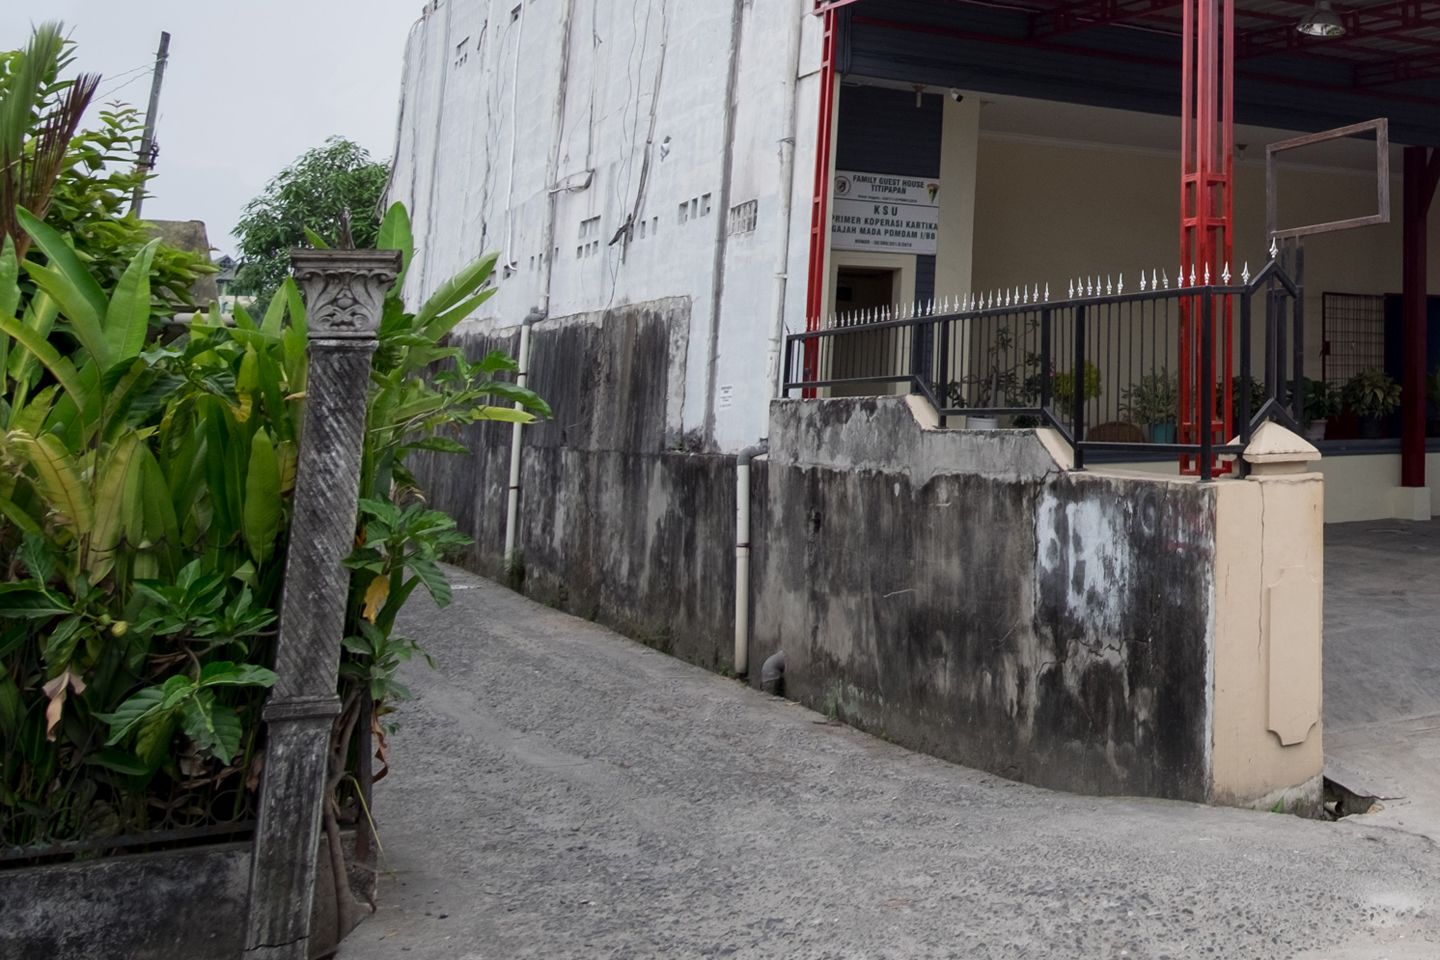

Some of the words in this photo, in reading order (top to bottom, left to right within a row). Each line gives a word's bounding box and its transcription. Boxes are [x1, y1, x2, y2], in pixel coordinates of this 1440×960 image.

[852, 174, 877, 184] FAMILY
[879, 177, 900, 186] GUEST
[902, 179, 924, 189] HOUSE
[871, 185, 907, 194] TITIPAPAN
[864, 217, 903, 228] KOPERASI
[906, 221, 938, 230] KARTIKA
[831, 225, 857, 234] GAJAH
[859, 227, 881, 236] MADA
[884, 228, 918, 239] POMDAM
